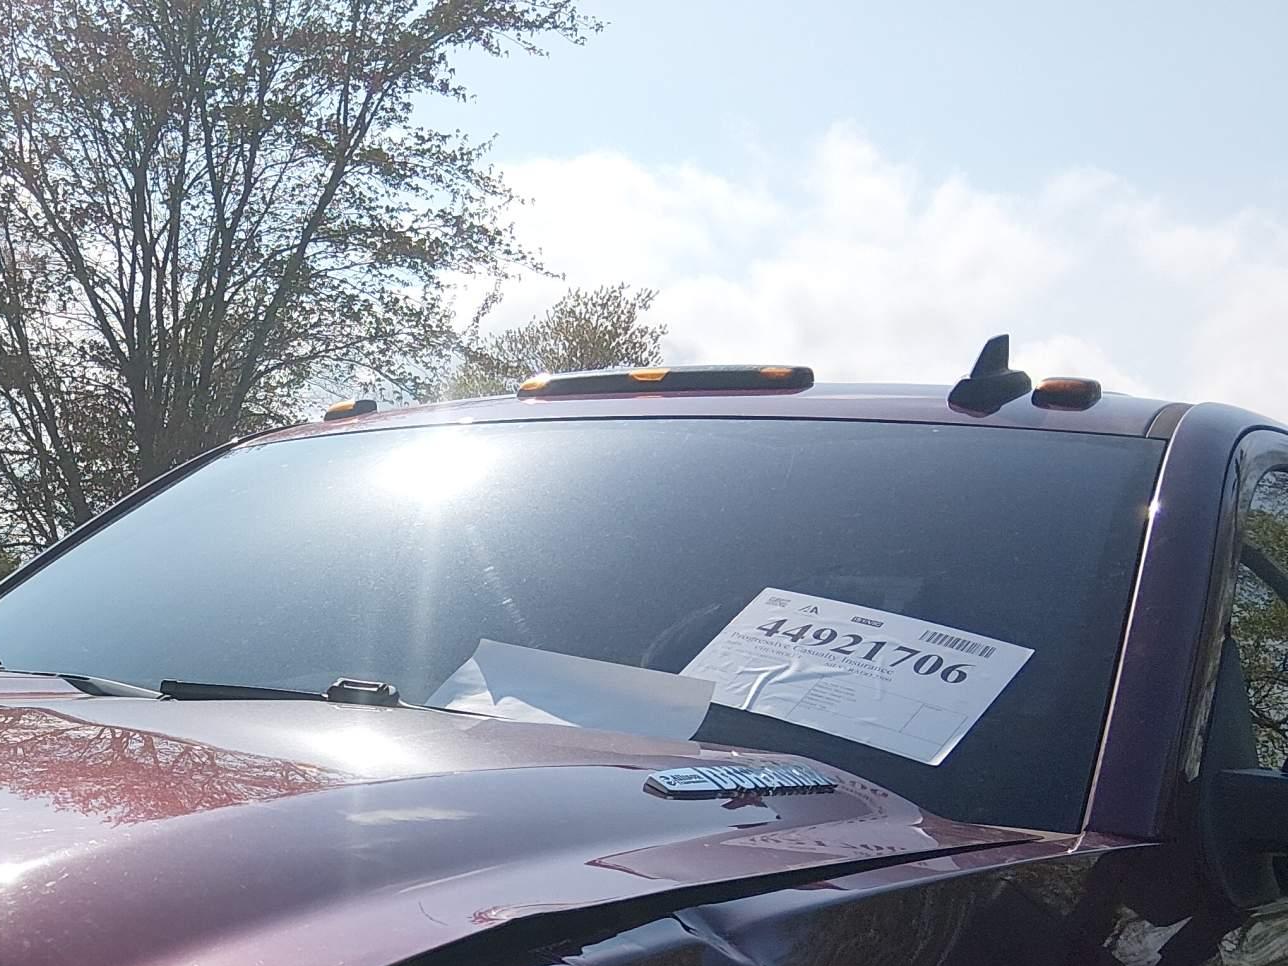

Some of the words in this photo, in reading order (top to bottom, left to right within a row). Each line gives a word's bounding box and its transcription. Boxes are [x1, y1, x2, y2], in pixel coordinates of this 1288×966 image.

[731, 631, 792, 651] Progressive
[792, 645, 836, 661] Casualty
[841, 657, 894, 675] Insurance
[756, 619, 976, 683] 44921706
[824, 661, 874, 678] SILVRADO
